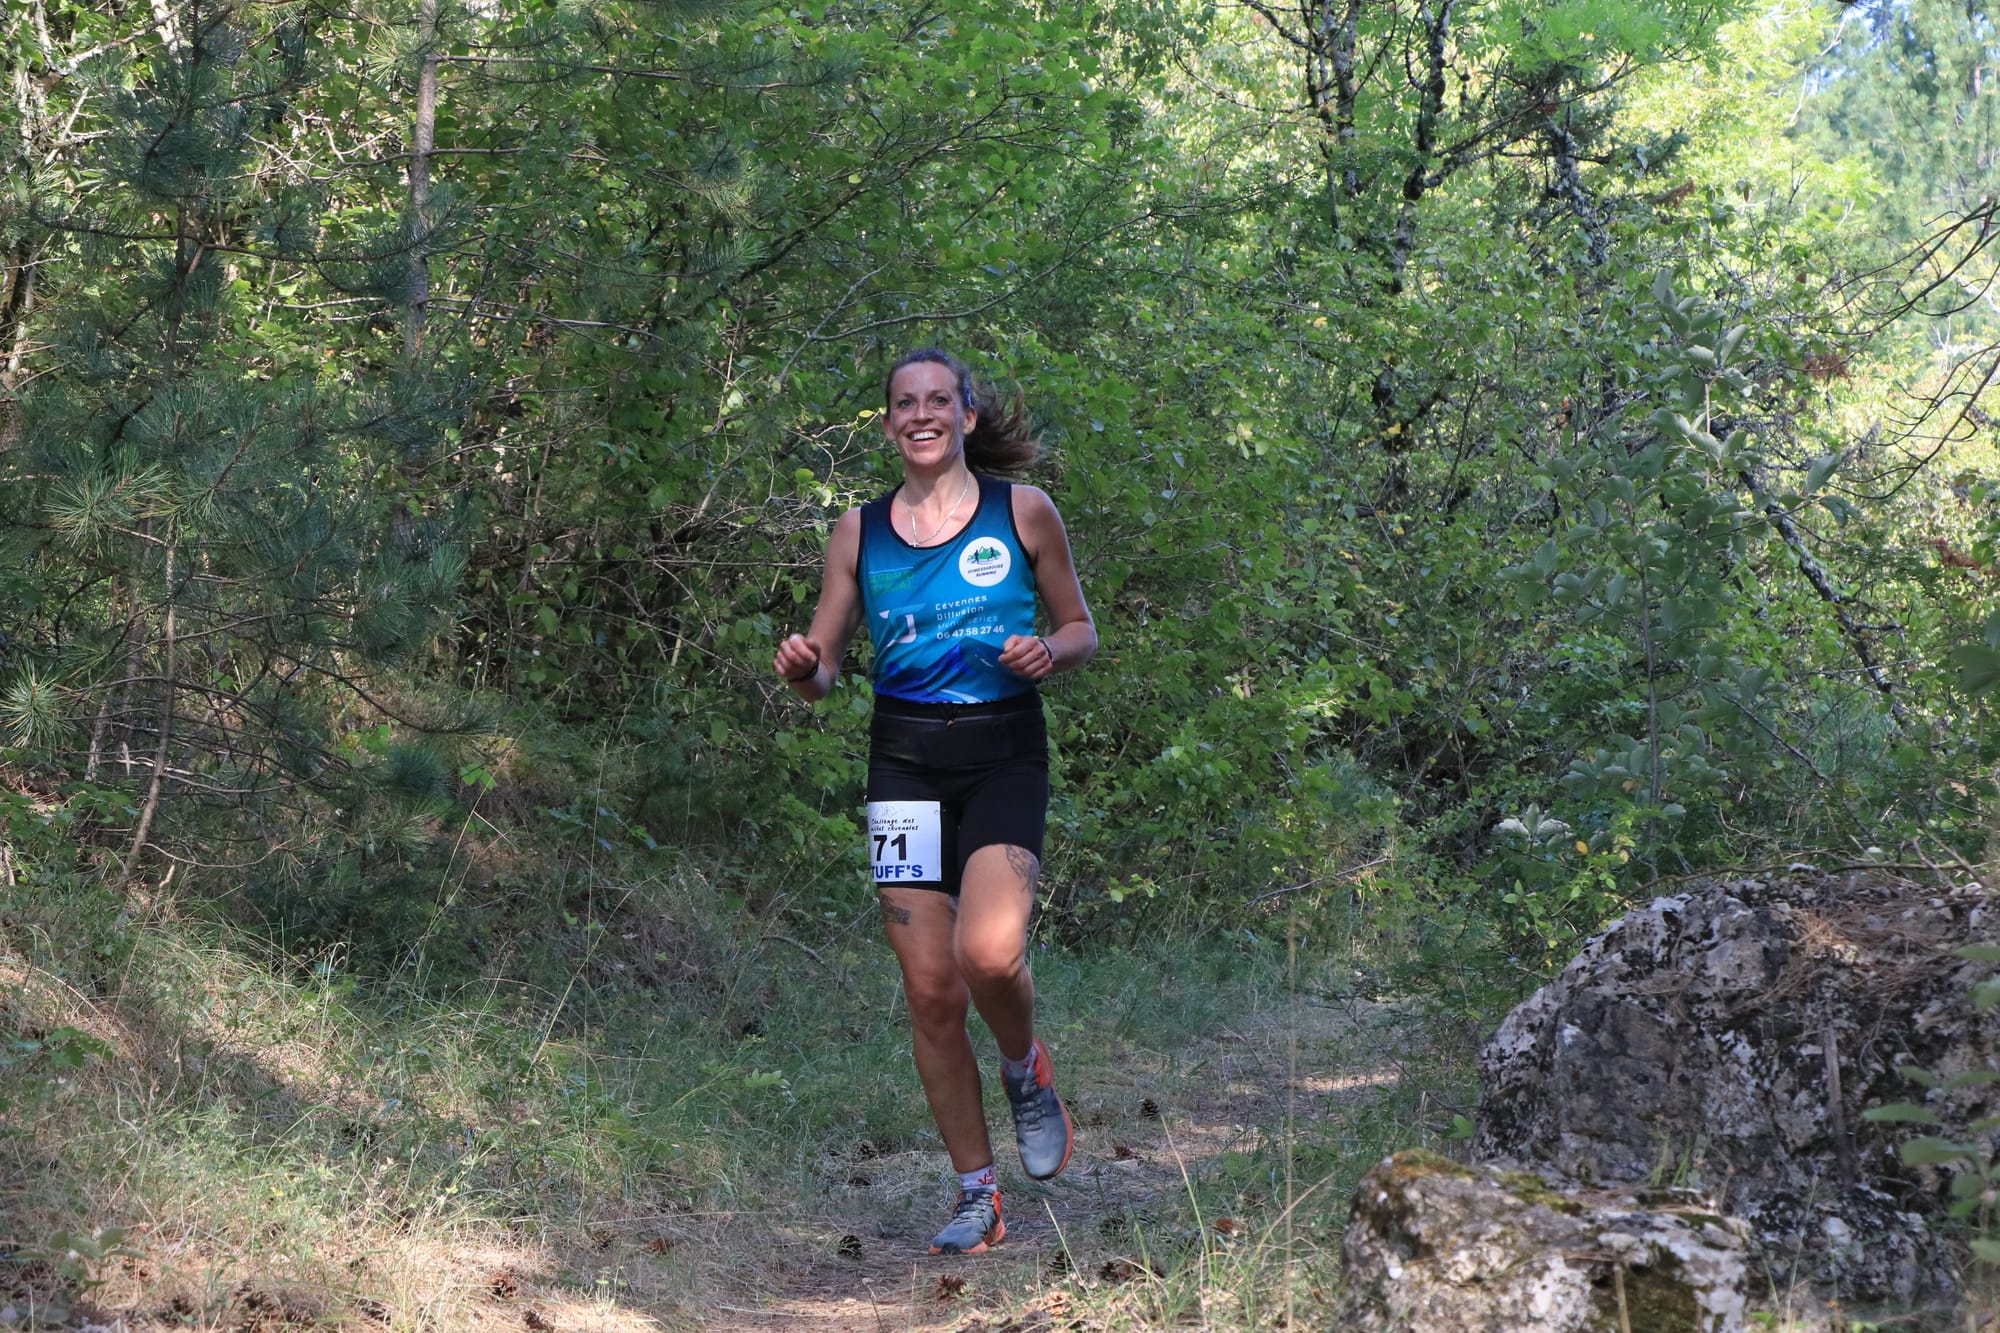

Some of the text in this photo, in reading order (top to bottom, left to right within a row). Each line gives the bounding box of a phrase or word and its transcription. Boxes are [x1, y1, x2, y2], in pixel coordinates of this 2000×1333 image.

[936, 605, 984, 621] Diffusion
[936, 624, 1005, 640] 06 47 58 27 46
[873, 833, 907, 862] 71
